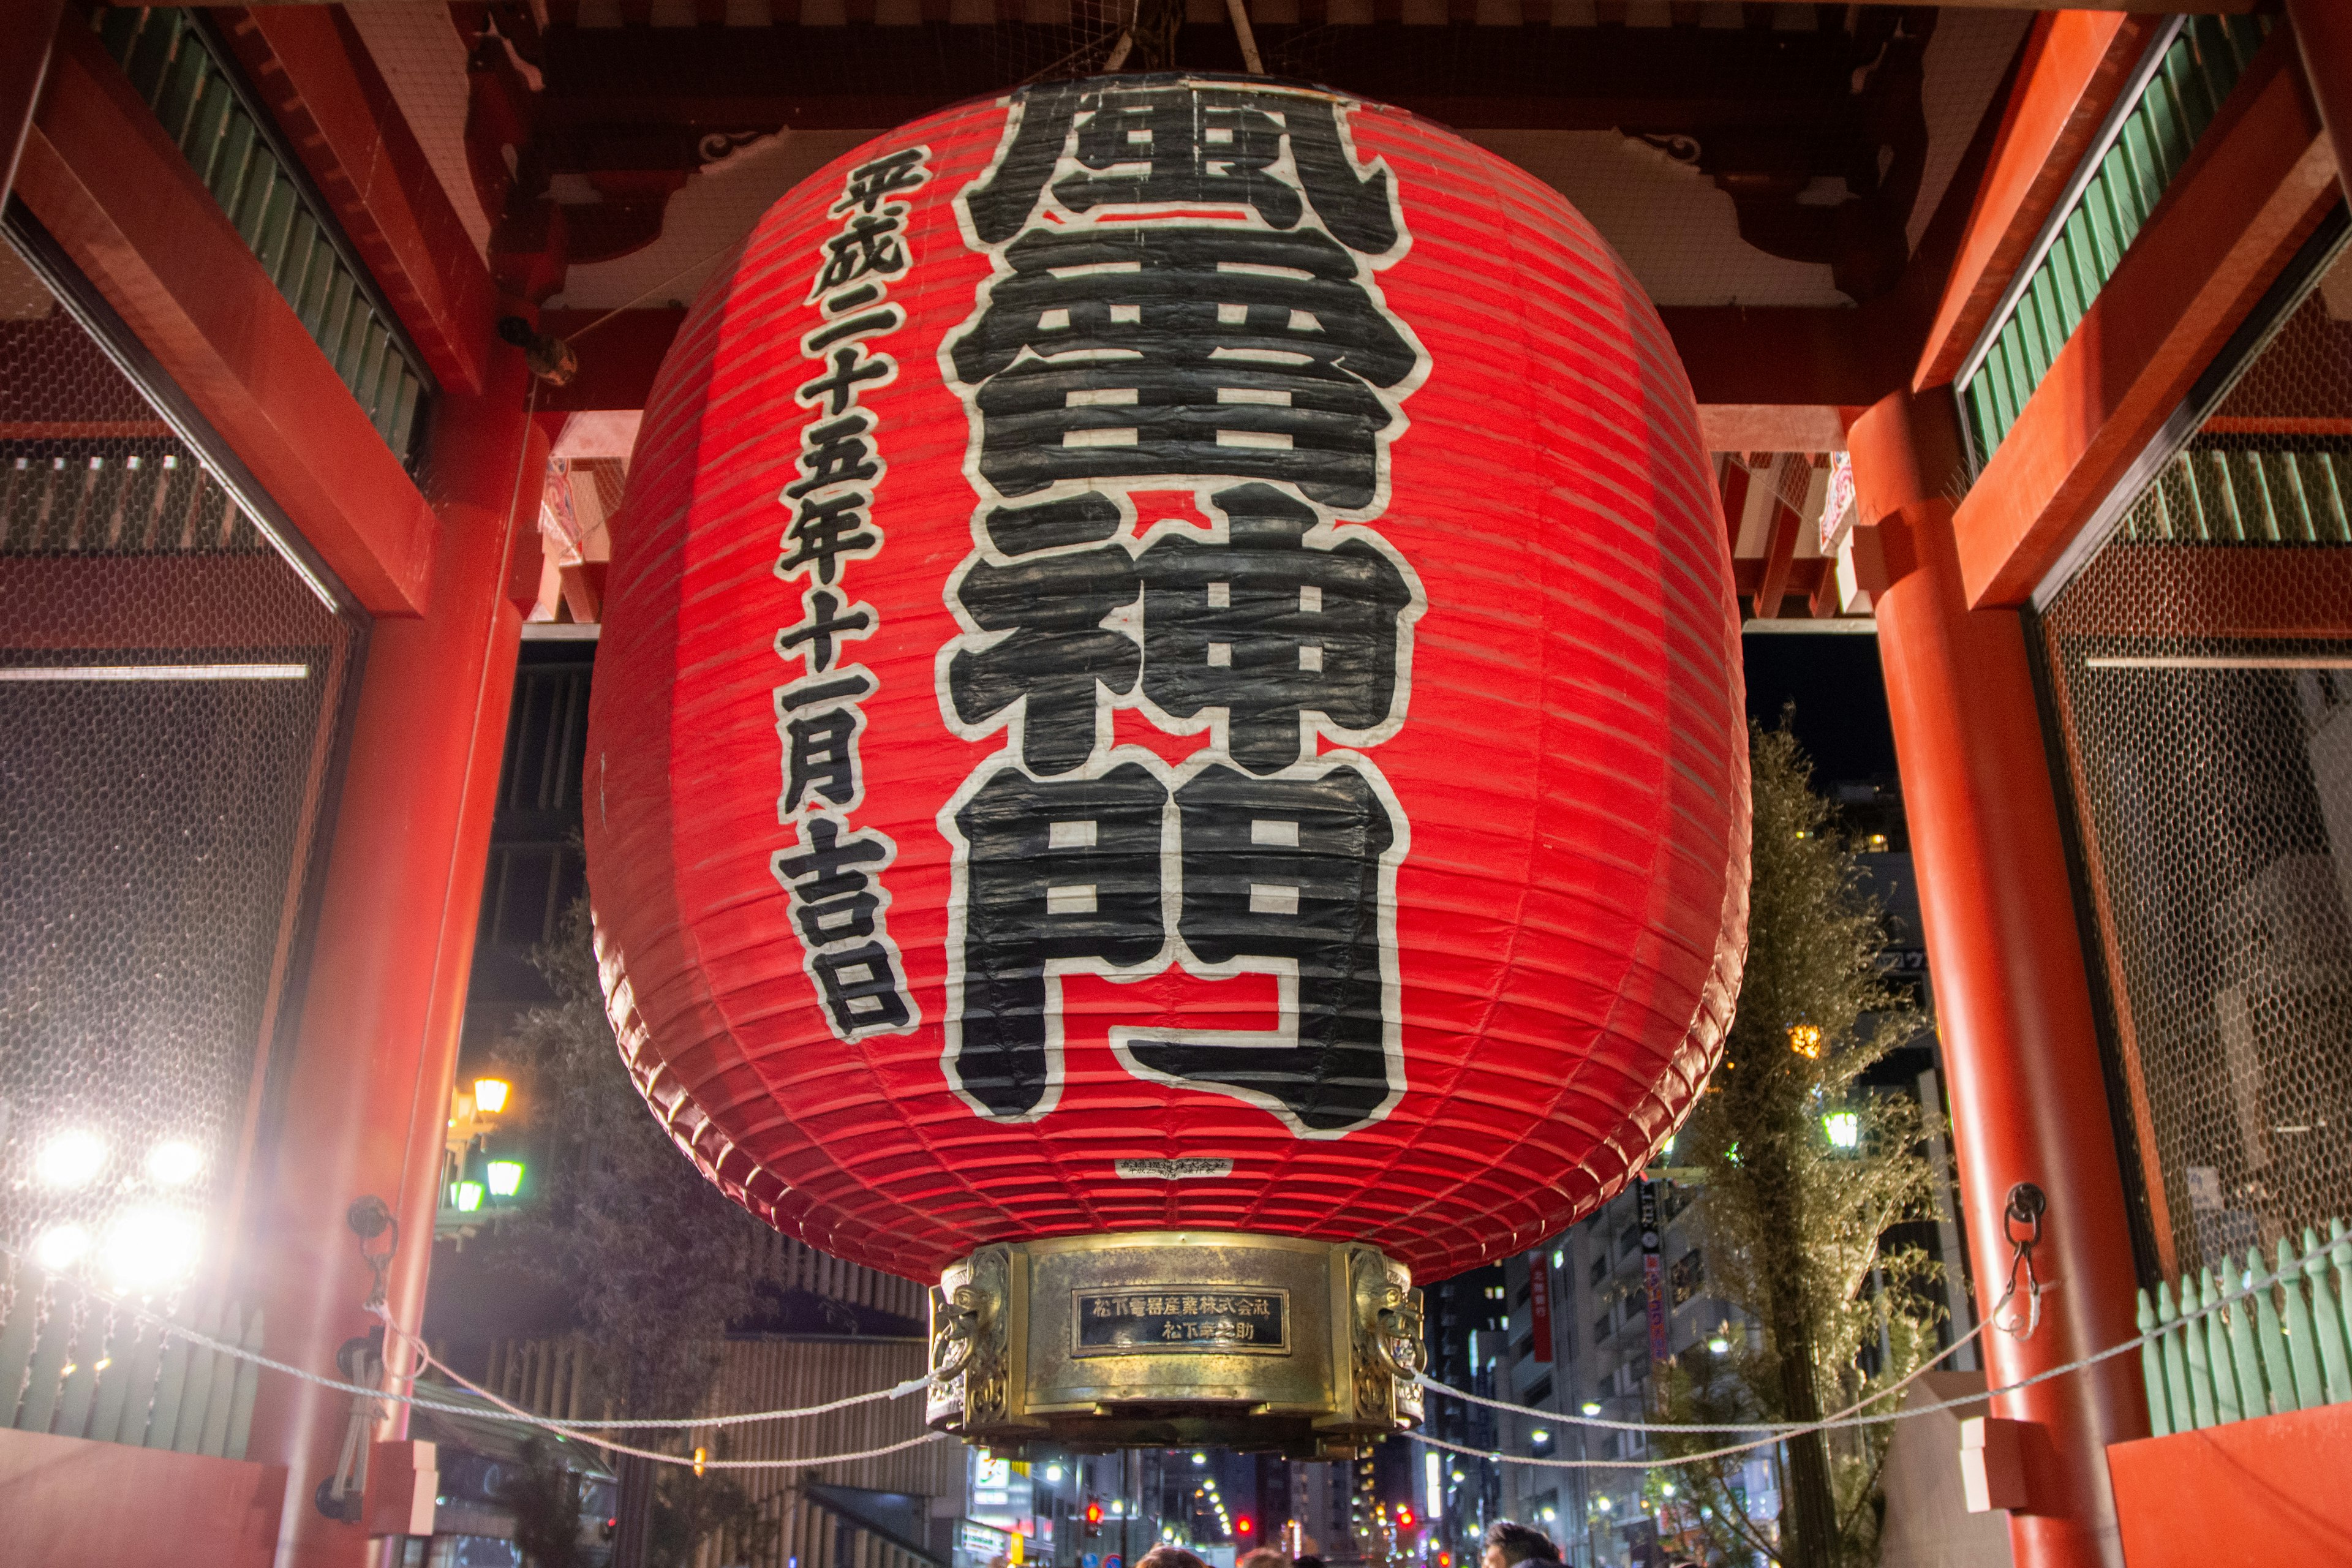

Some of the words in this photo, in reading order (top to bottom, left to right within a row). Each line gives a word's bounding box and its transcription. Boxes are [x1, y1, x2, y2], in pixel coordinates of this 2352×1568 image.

[773, 146, 932, 1040] 平成二十五年十一月吉日
[1093, 1296, 1271, 1317] 松下電器産業株式会社
[1161, 1320, 1254, 1341] 松下幸之助
